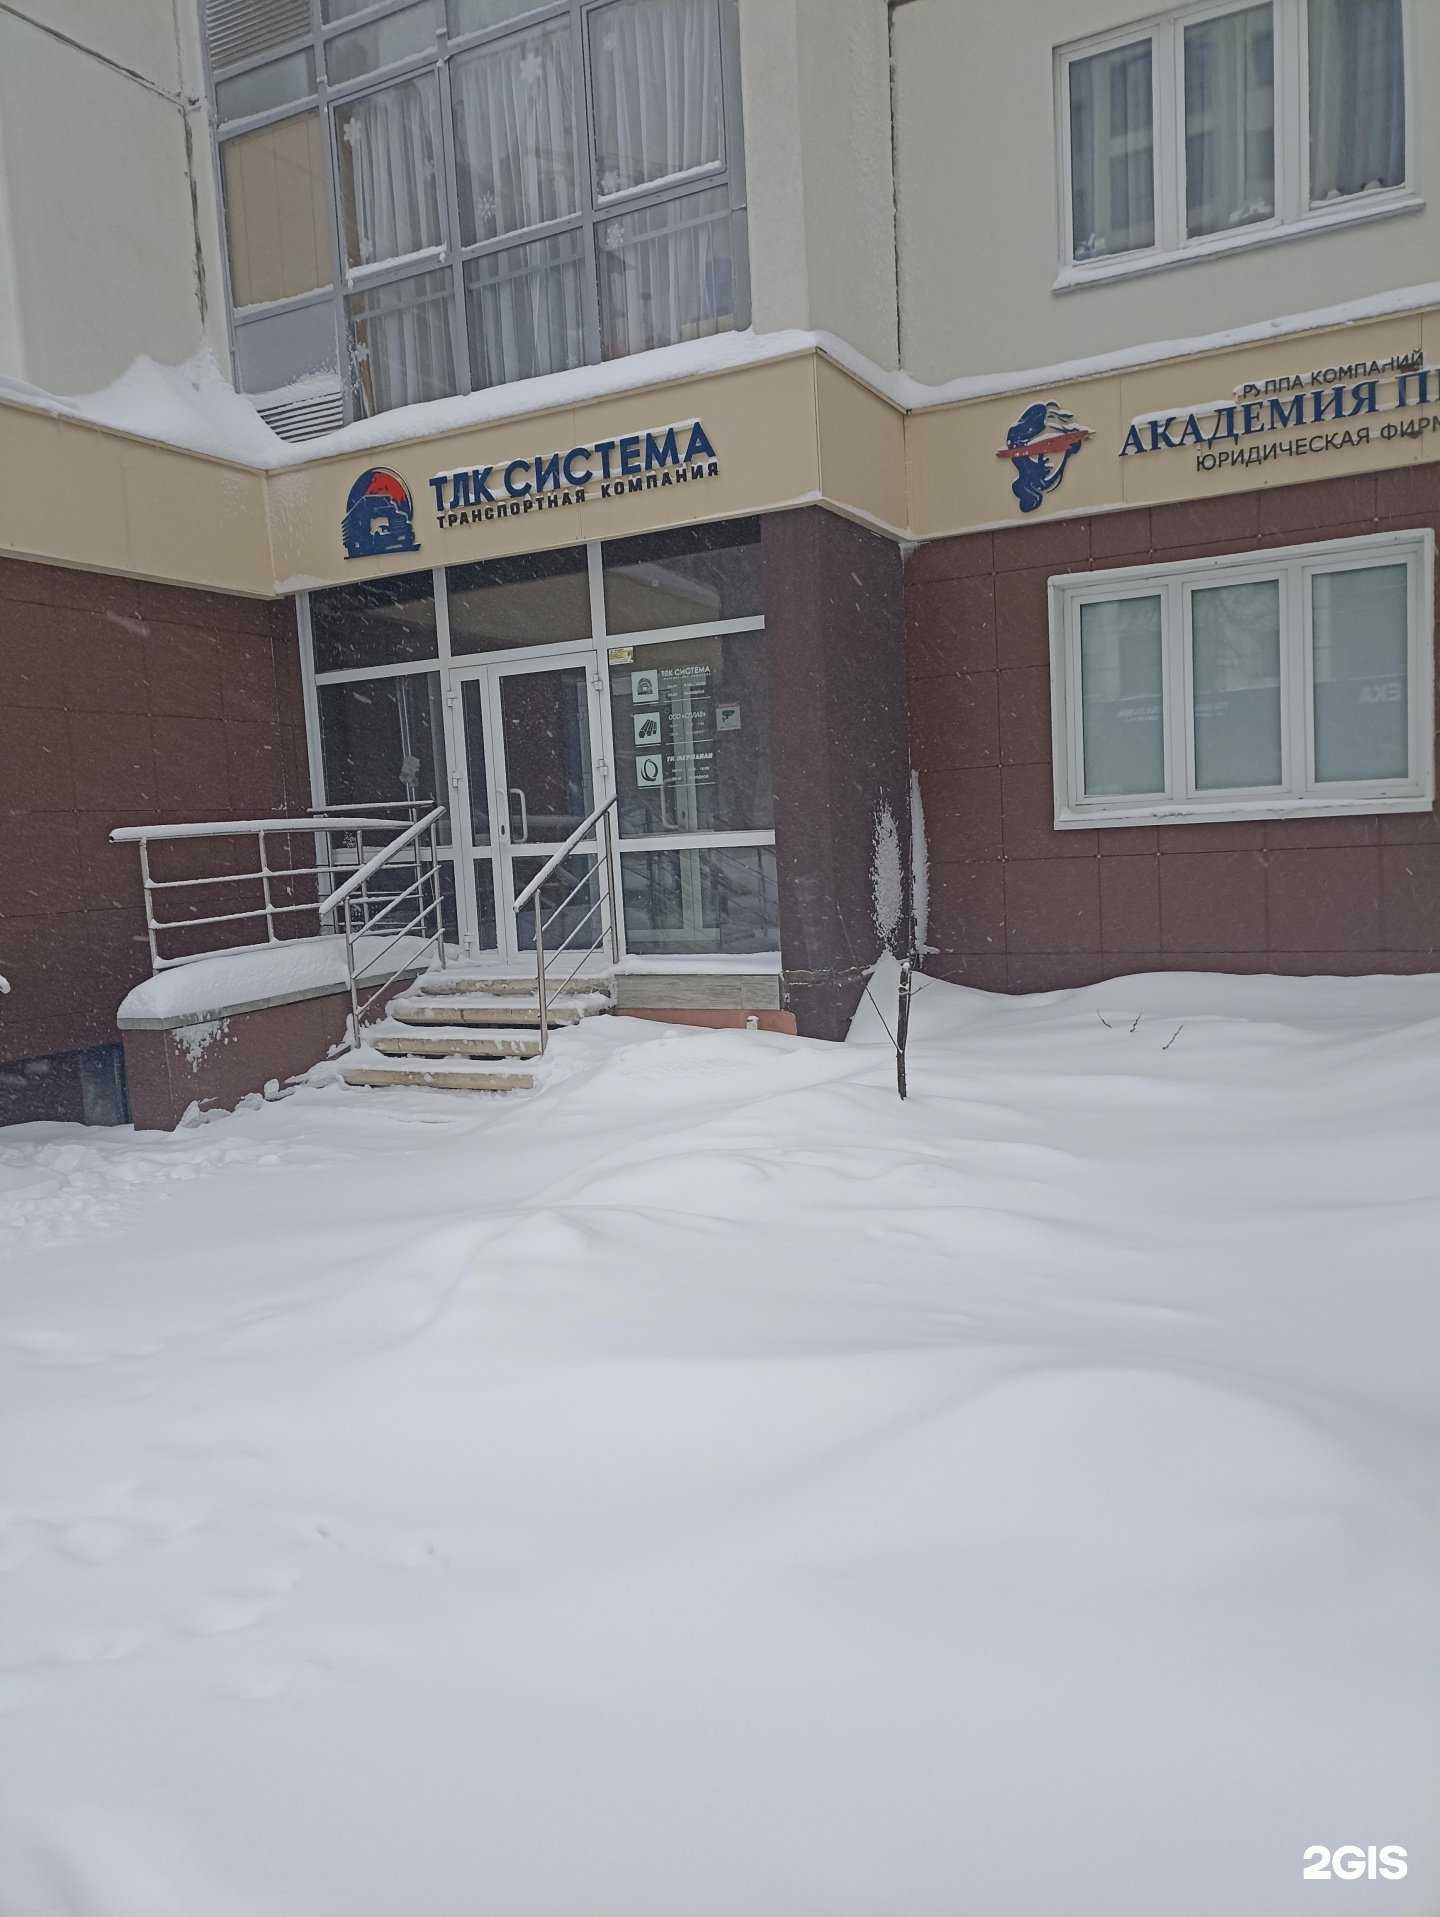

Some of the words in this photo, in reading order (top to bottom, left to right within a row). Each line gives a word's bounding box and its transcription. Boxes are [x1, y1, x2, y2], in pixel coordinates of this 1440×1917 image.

[1311, 348, 1424, 386] КОМПАНИЙ
[1119, 379, 1380, 457] АКАДЕМИЯ
[1394, 367, 1440, 409] П
[429, 465, 495, 512] ТЛК
[503, 421, 717, 497] СИСТЕМА
[1196, 427, 1370, 473] ЮРИДИЧЕСКАЯ
[436, 488, 587, 529] ТРАНСПОРТНАЯ
[601, 461, 719, 498] КОМПАНИЯ
[674, 664, 711, 676] СИСТЕМА
